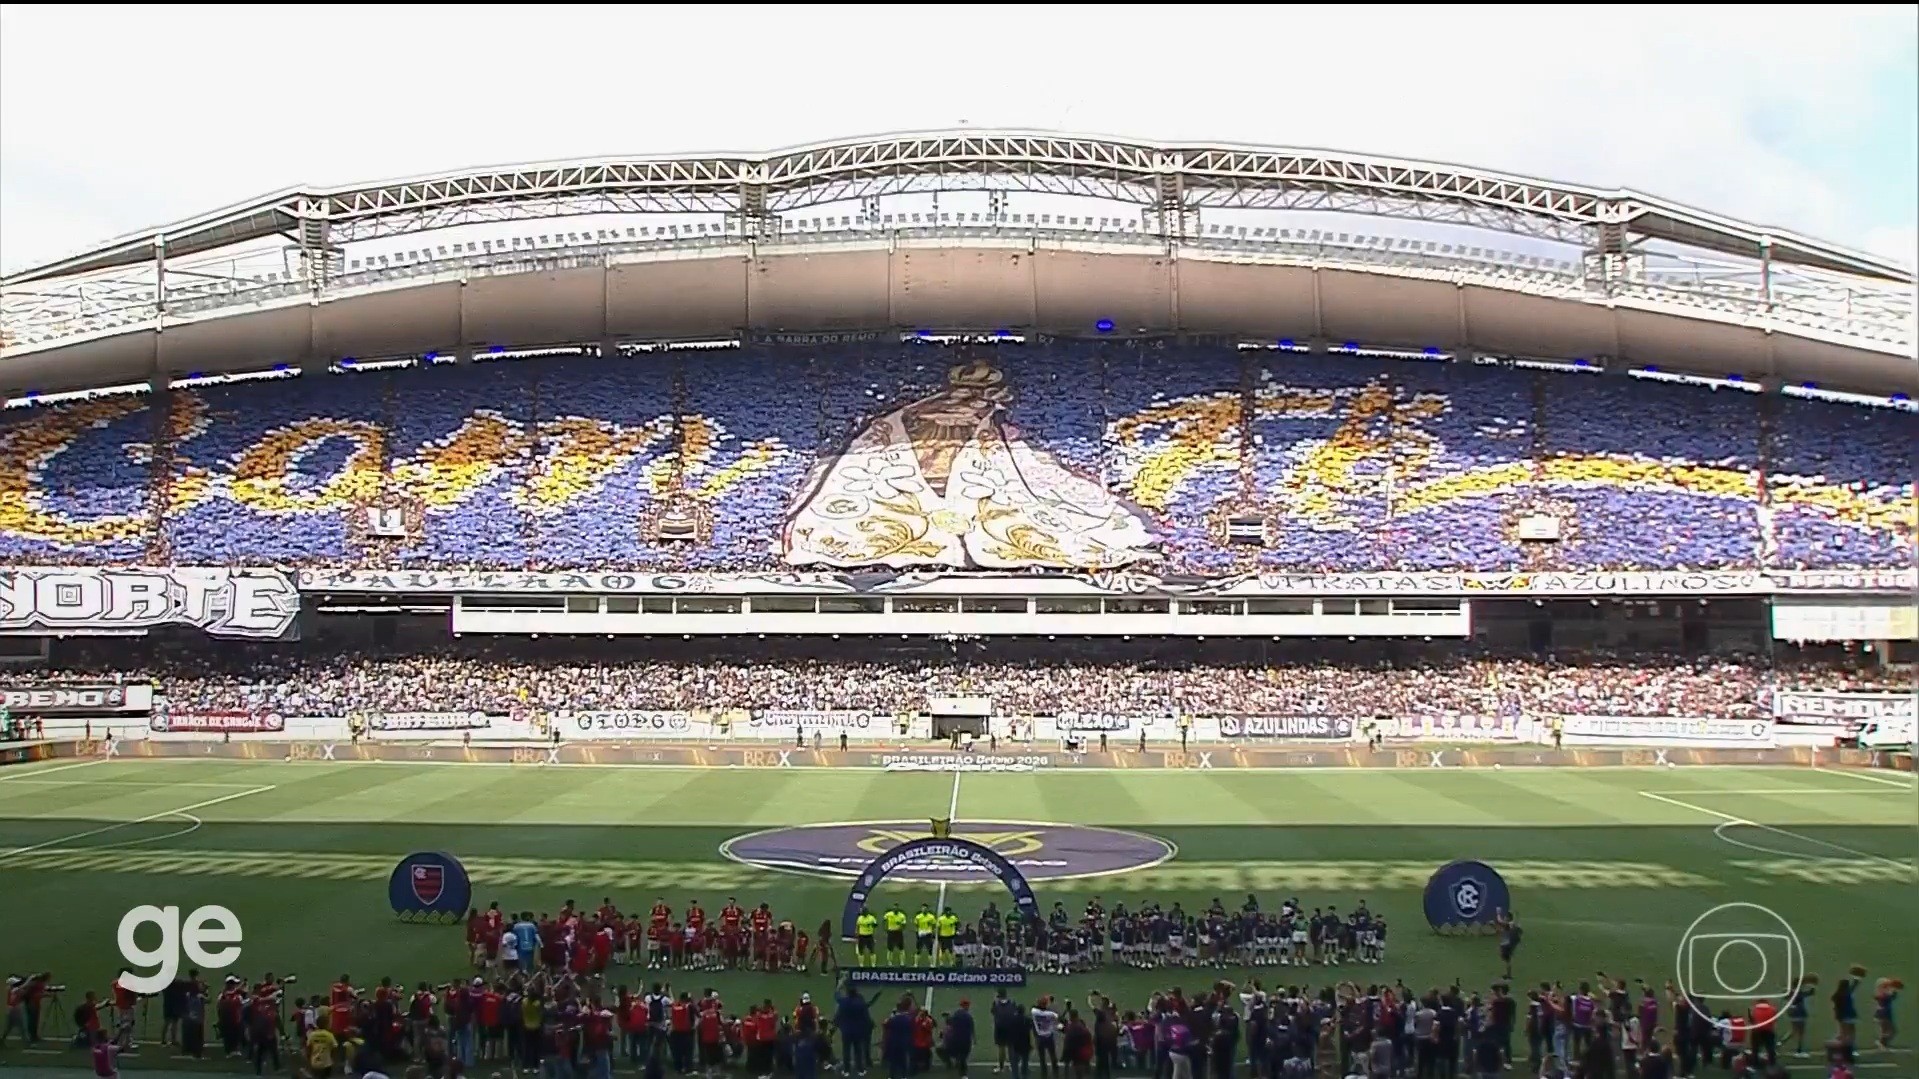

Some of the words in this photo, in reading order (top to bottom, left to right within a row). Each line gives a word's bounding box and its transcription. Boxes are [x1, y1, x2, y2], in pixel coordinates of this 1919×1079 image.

[1243, 717, 1329, 734] AZULINDAS
[743, 750, 791, 768] BRAX
[1163, 751, 1213, 768] BRAX
[881, 845, 969, 872] BRASILEIRÃO
[851, 970, 945, 982] BRASILEIRÃO
[948, 972, 987, 983] Betano
[989, 973, 1024, 983] 2026
